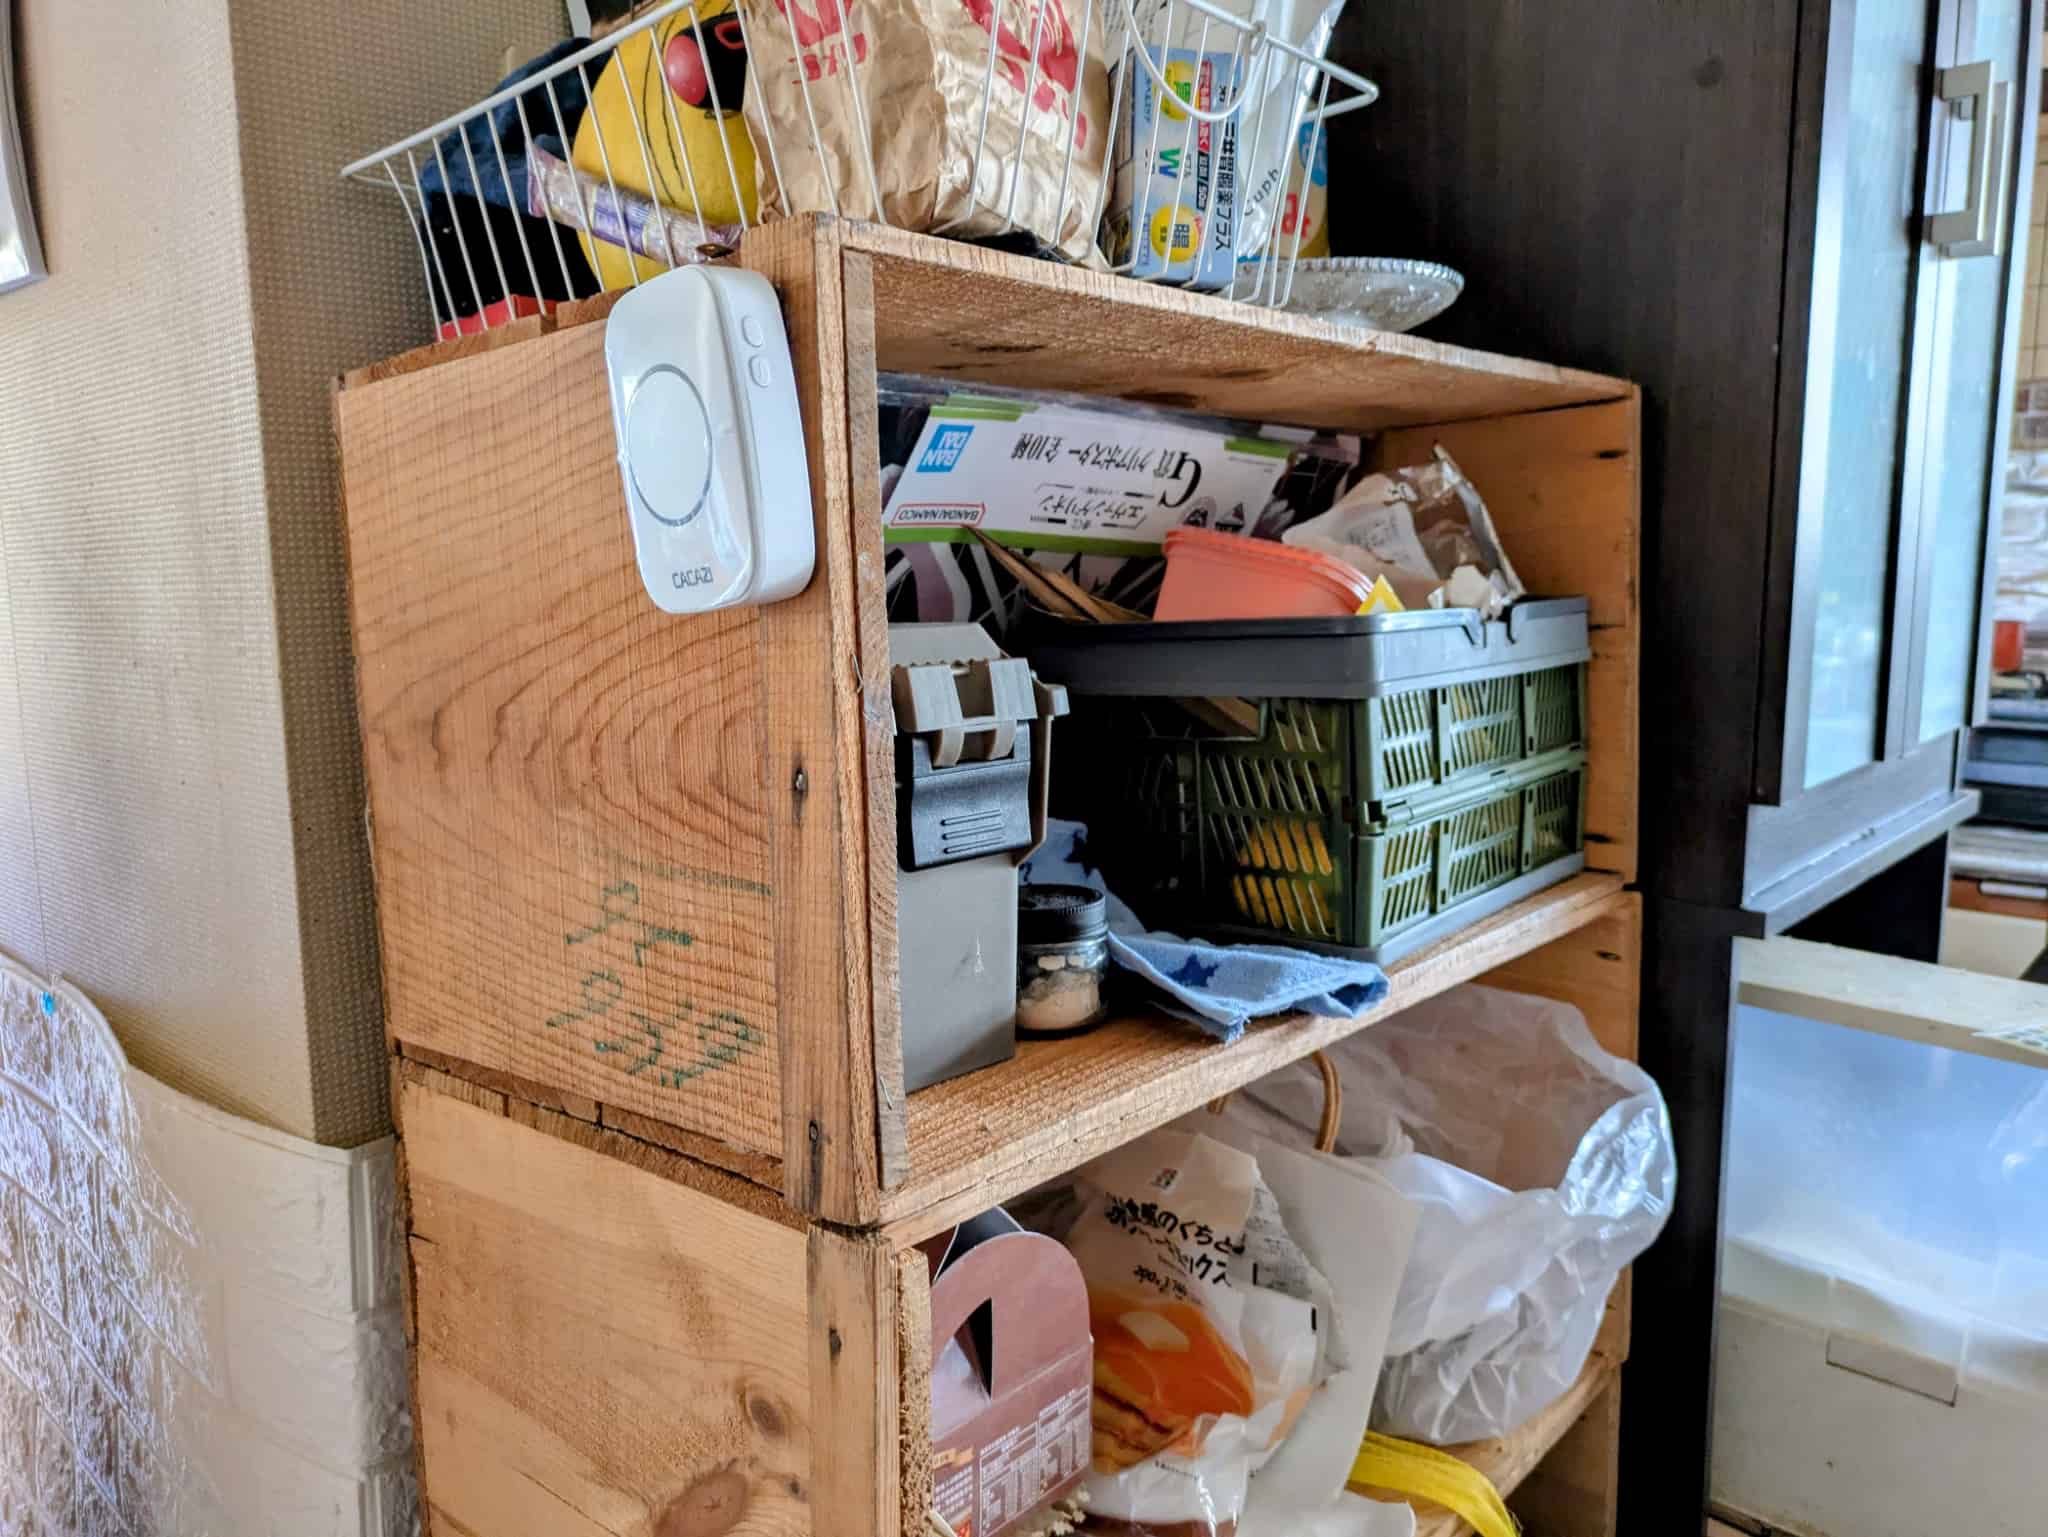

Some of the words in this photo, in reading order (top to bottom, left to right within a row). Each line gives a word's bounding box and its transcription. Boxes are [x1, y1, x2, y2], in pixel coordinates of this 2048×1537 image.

[1159, 147, 1182, 179] W
[1038, 494, 1145, 520] エヴァンゲリオン
[671, 566, 714, 590] CACAZI
